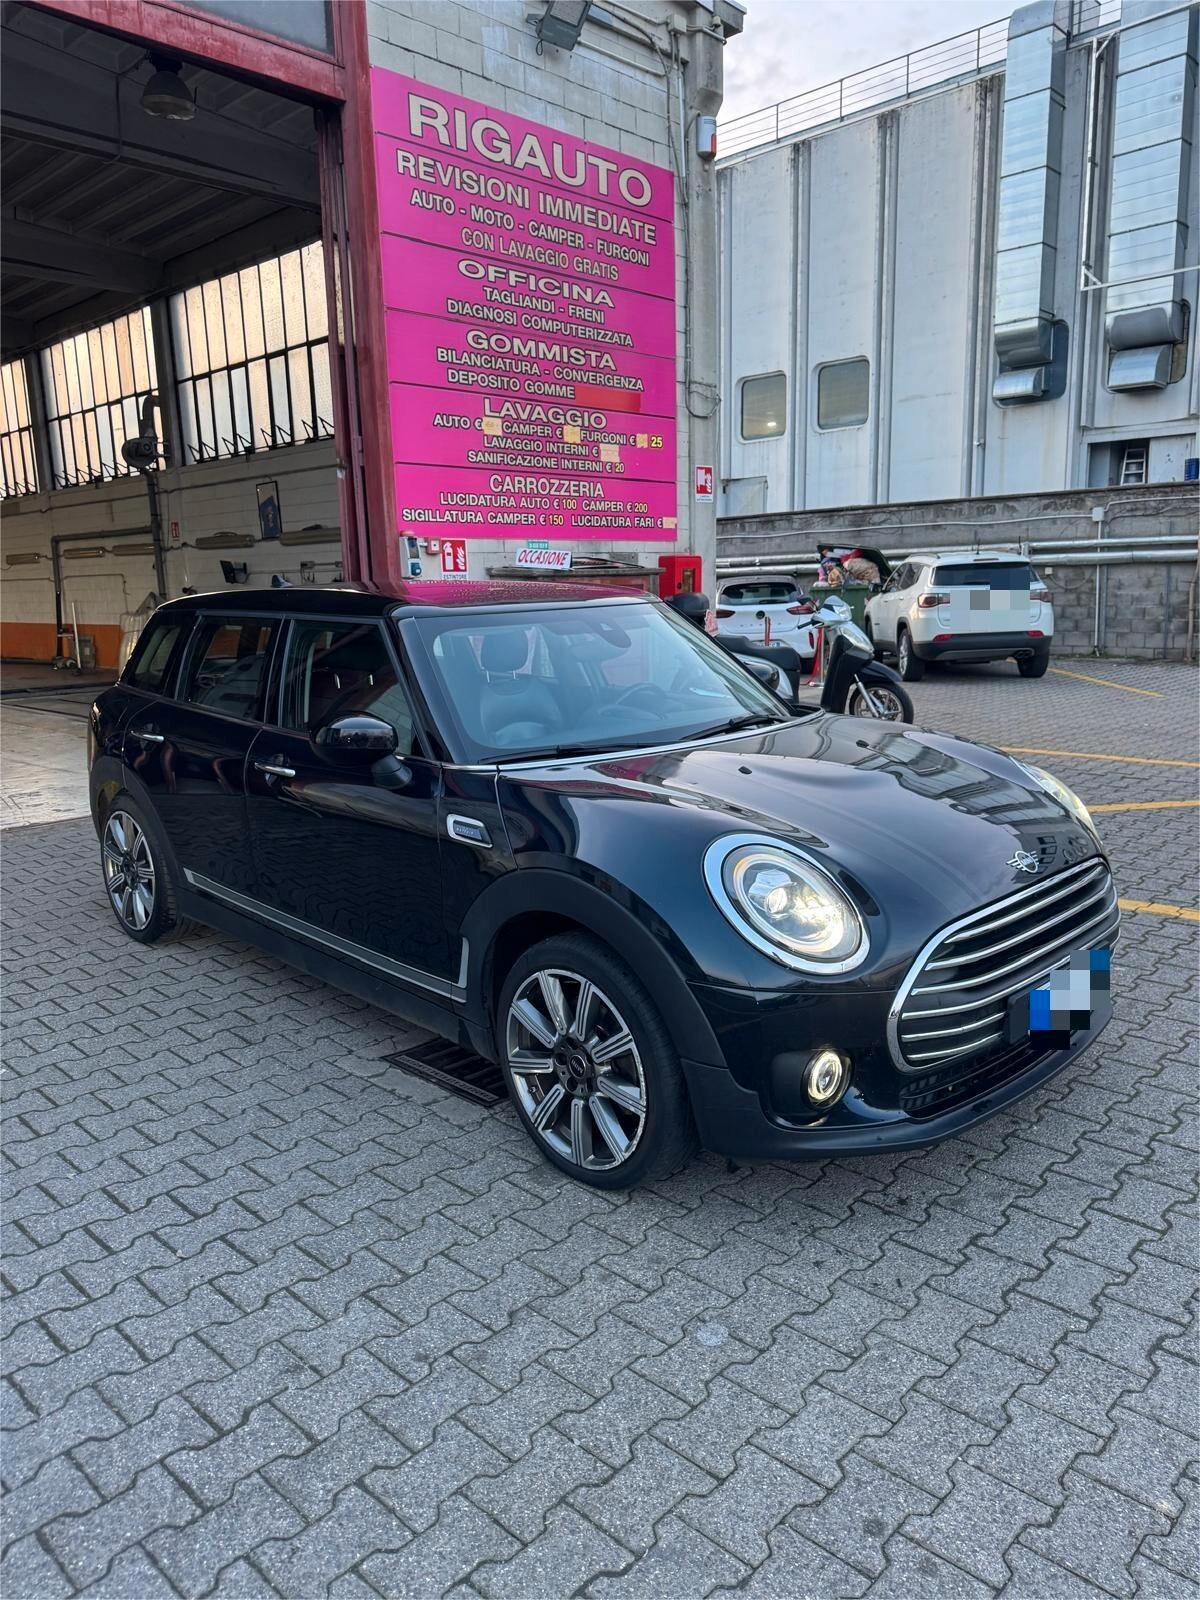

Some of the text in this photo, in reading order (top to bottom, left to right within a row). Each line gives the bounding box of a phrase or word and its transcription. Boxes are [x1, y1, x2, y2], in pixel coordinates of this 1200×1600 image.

[407, 92, 653, 207] RIGAUTO
[396, 149, 657, 246] REVISIONI IMMEDIATE
[410, 189, 455, 215] AUTO
[470, 207, 514, 231] MOTO
[528, 221, 584, 250] CAMPER
[596, 239, 649, 267] FURGONI
[461, 227, 619, 281] CON LAVAGGIO GRATIS
[457, 258, 615, 308] OFFICINA
[447, 298, 634, 348] DIAGNOSI COMPUTERIZZATA
[483, 286, 555, 313] TAGLIANDI
[568, 305, 605, 324] FRENI
[466, 329, 617, 371] GOMMISTA
[437, 348, 540, 376] BILANCIATURA
[553, 366, 643, 391] CONVERGENZA
[447, 369, 576, 399] DEPOSITO GOMME
[433, 414, 470, 429] AUTO
[502, 422, 552, 438] CAMPER
[555, 427, 563, 439] €
[580, 430, 627, 445] FURGONI
[629, 434, 636, 446] €
[650, 435, 663, 448] 25
[483, 397, 607, 430] LAVAGGIO
[467, 450, 625, 473] SANIFICAZIONE INTERNI € 20
[483, 435, 599, 457] LAVAGGIO INTERNI €
[440, 492, 648, 513] LUCIDATURA AUTO € 100 CAMPER € 200
[489, 474, 605, 498] CARROZZERIA
[402, 509, 484, 524] SIGILLATURA
[487, 512, 536, 525] CAMPER
[539, 514, 546, 526] €
[548, 514, 564, 526] 150
[571, 514, 632, 528] LUCIDATURA
[634, 516, 655, 529] FARI
[517, 549, 569, 566] OCCASIONE
